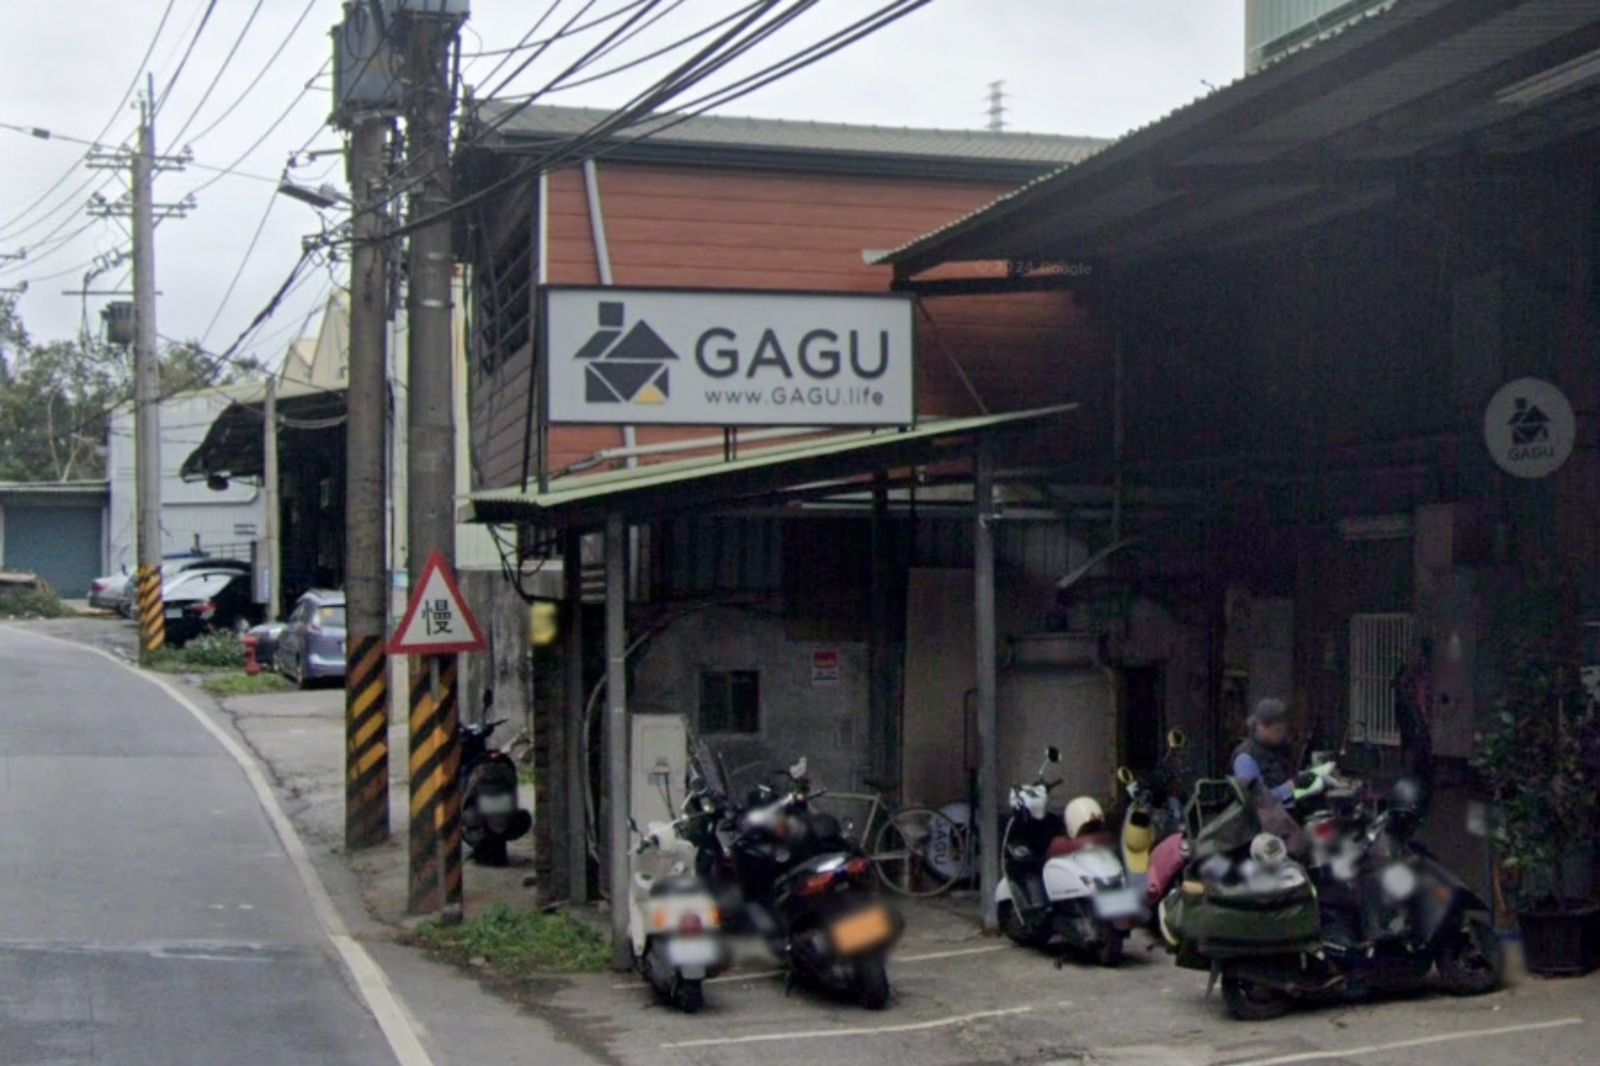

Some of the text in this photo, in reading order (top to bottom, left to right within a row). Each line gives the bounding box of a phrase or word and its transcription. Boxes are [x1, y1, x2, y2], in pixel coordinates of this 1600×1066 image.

[695, 327, 889, 380] GAGU
[704, 387, 884, 406] www.GAGU.life
[1507, 445, 1554, 461] GAGU
[421, 599, 454, 636] 慢
